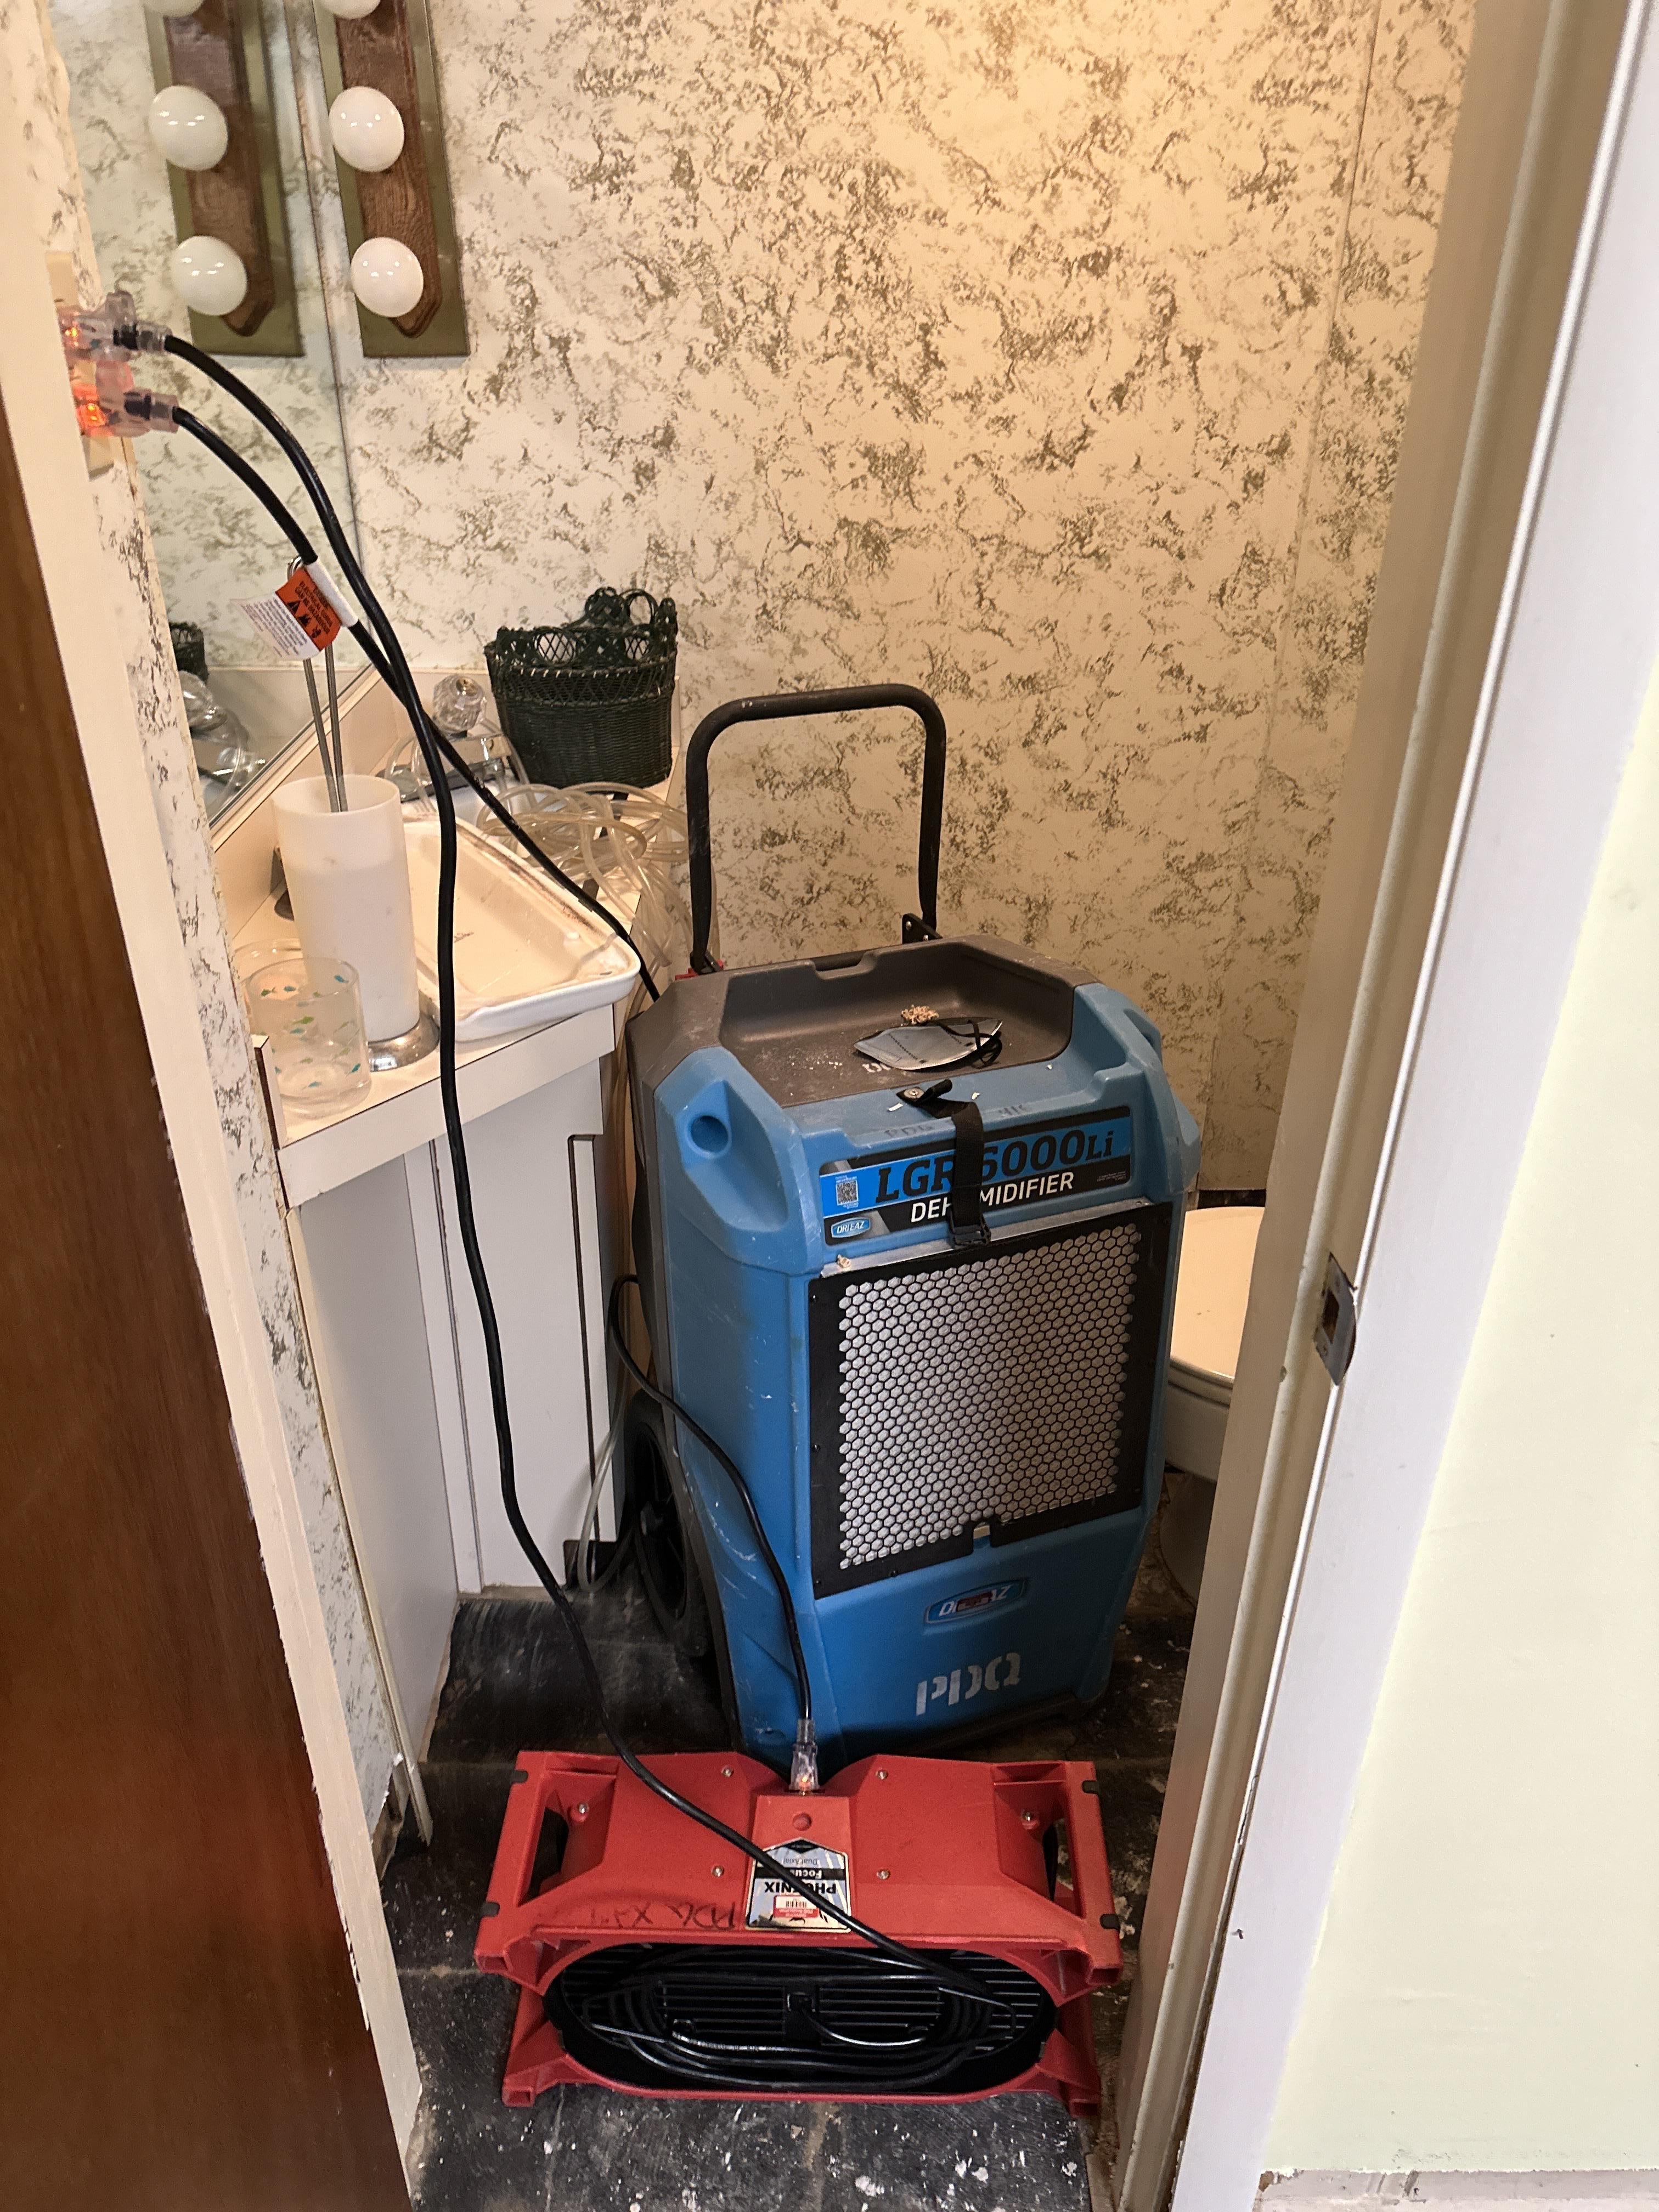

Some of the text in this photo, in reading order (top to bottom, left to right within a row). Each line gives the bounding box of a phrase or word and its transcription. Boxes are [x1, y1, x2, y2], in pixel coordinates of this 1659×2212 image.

[911, 1171, 1074, 1223] DEHMIDIFIER
[916, 1652, 1021, 1716] PDQ
[765, 1882, 836, 1894] PHNIX
